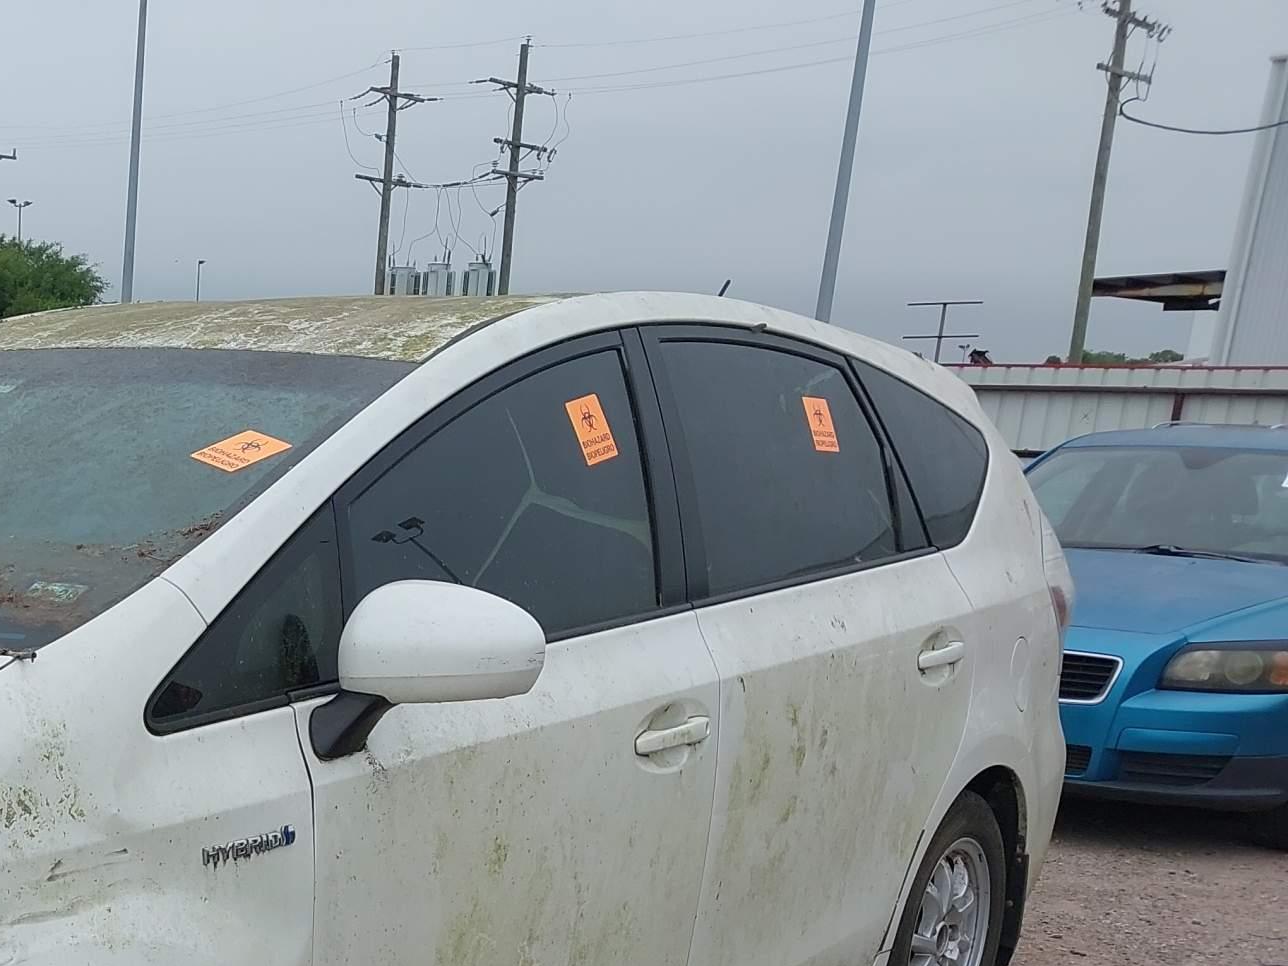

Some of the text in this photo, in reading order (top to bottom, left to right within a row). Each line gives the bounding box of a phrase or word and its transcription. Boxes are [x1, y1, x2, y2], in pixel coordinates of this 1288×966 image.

[582, 433, 611, 449] BIOHAZARD
[208, 447, 250, 464] BIOHAZARD
[587, 443, 615, 460] BIOPELIGRO
[202, 831, 282, 866] HYBRID
